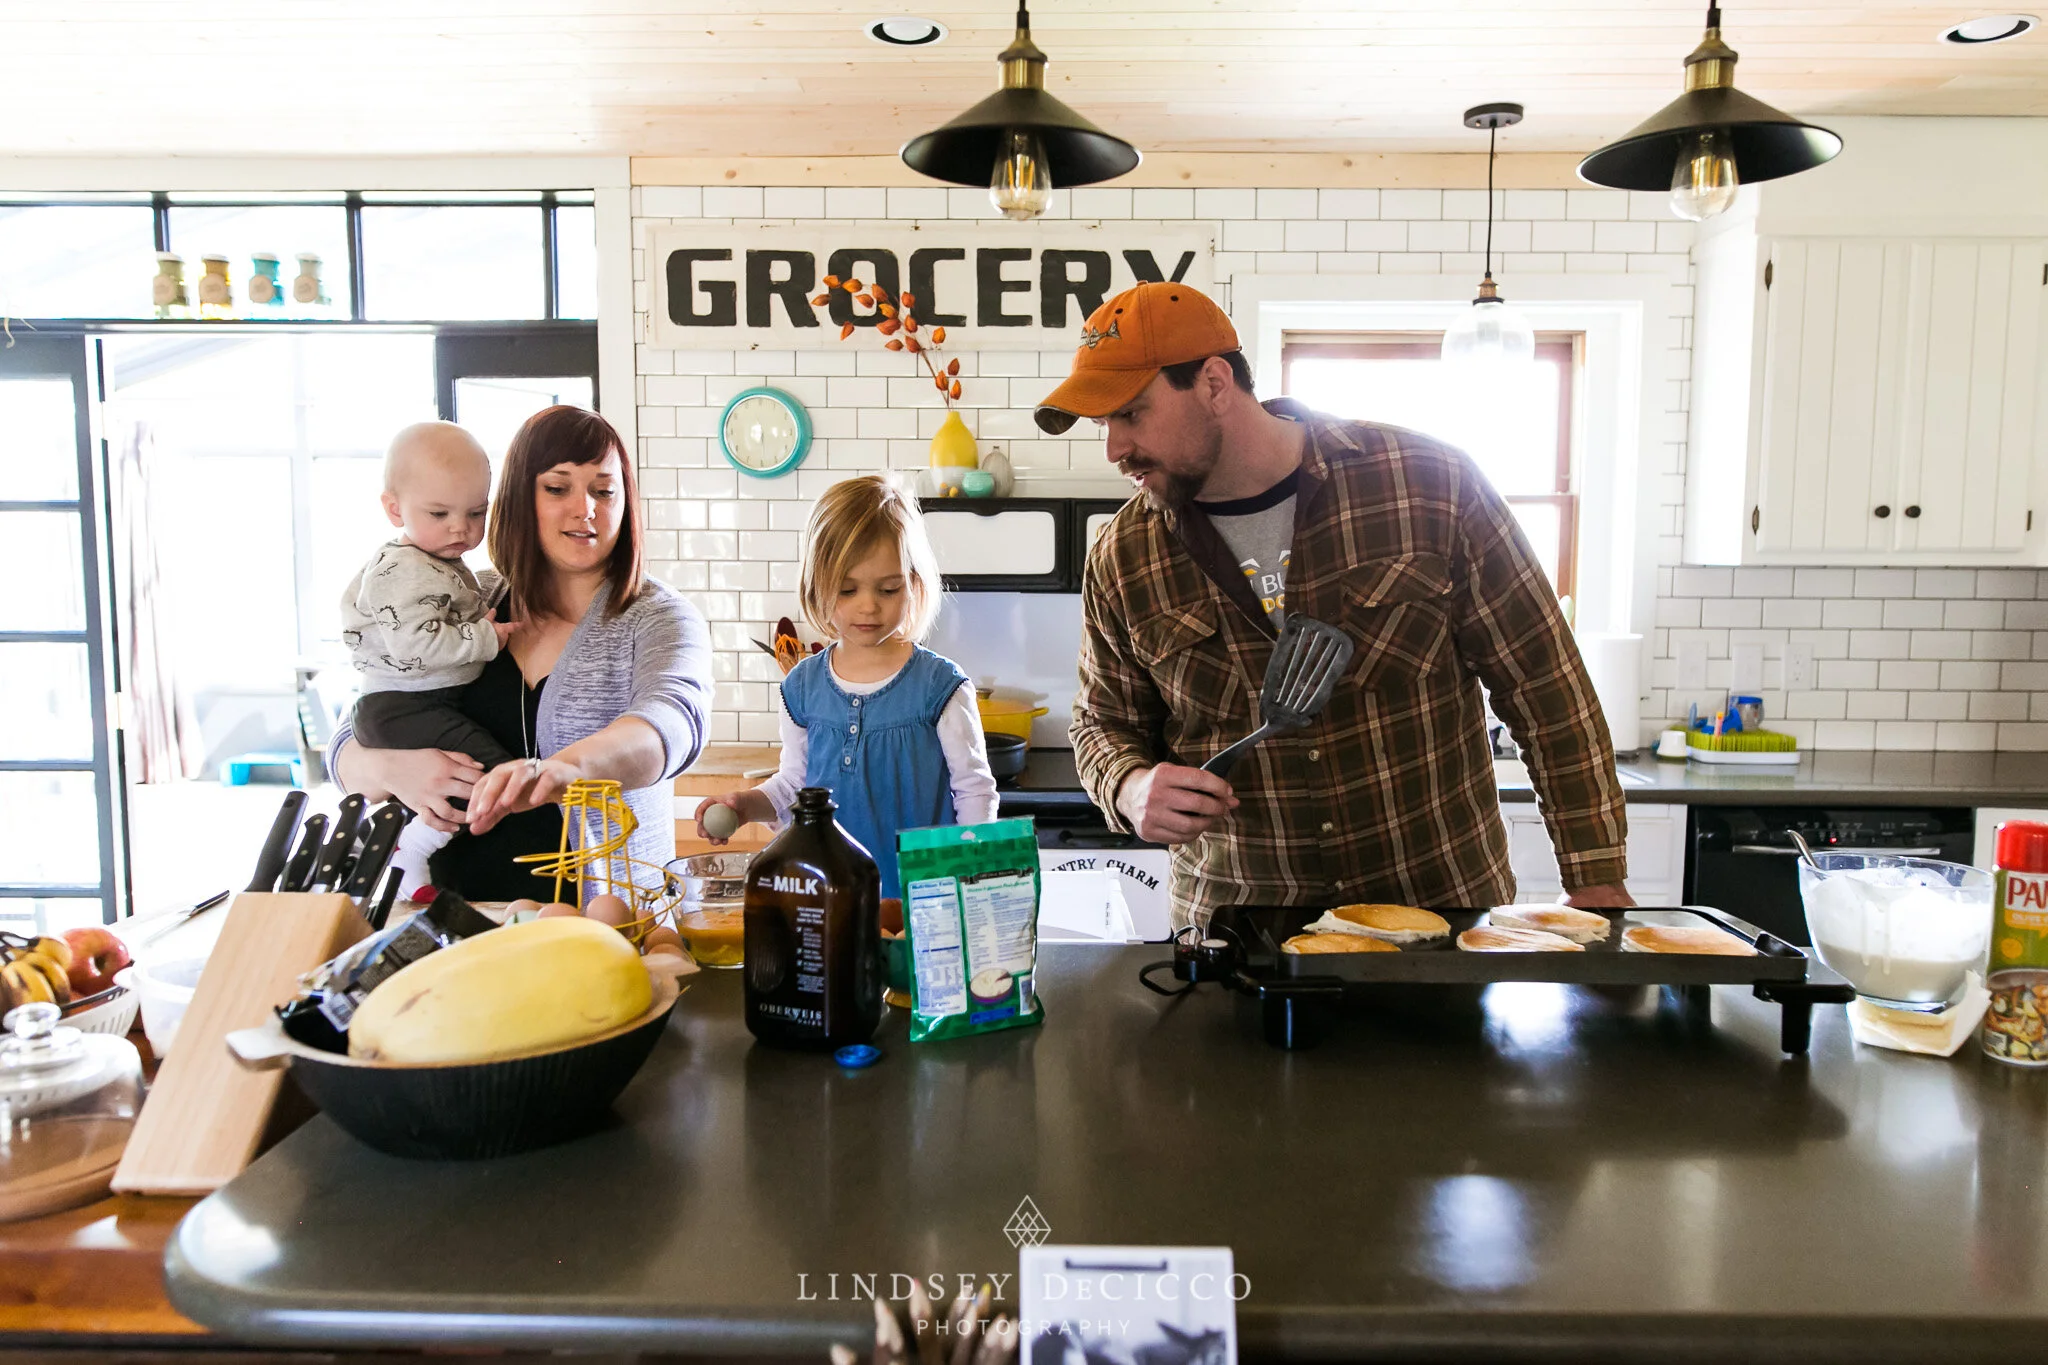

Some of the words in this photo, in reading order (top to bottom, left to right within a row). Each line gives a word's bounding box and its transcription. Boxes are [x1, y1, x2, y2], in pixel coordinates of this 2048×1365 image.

[773, 875, 819, 896] MILK
[1051, 858, 1097, 872] NTRY
[1106, 859, 1160, 890] CHARM
